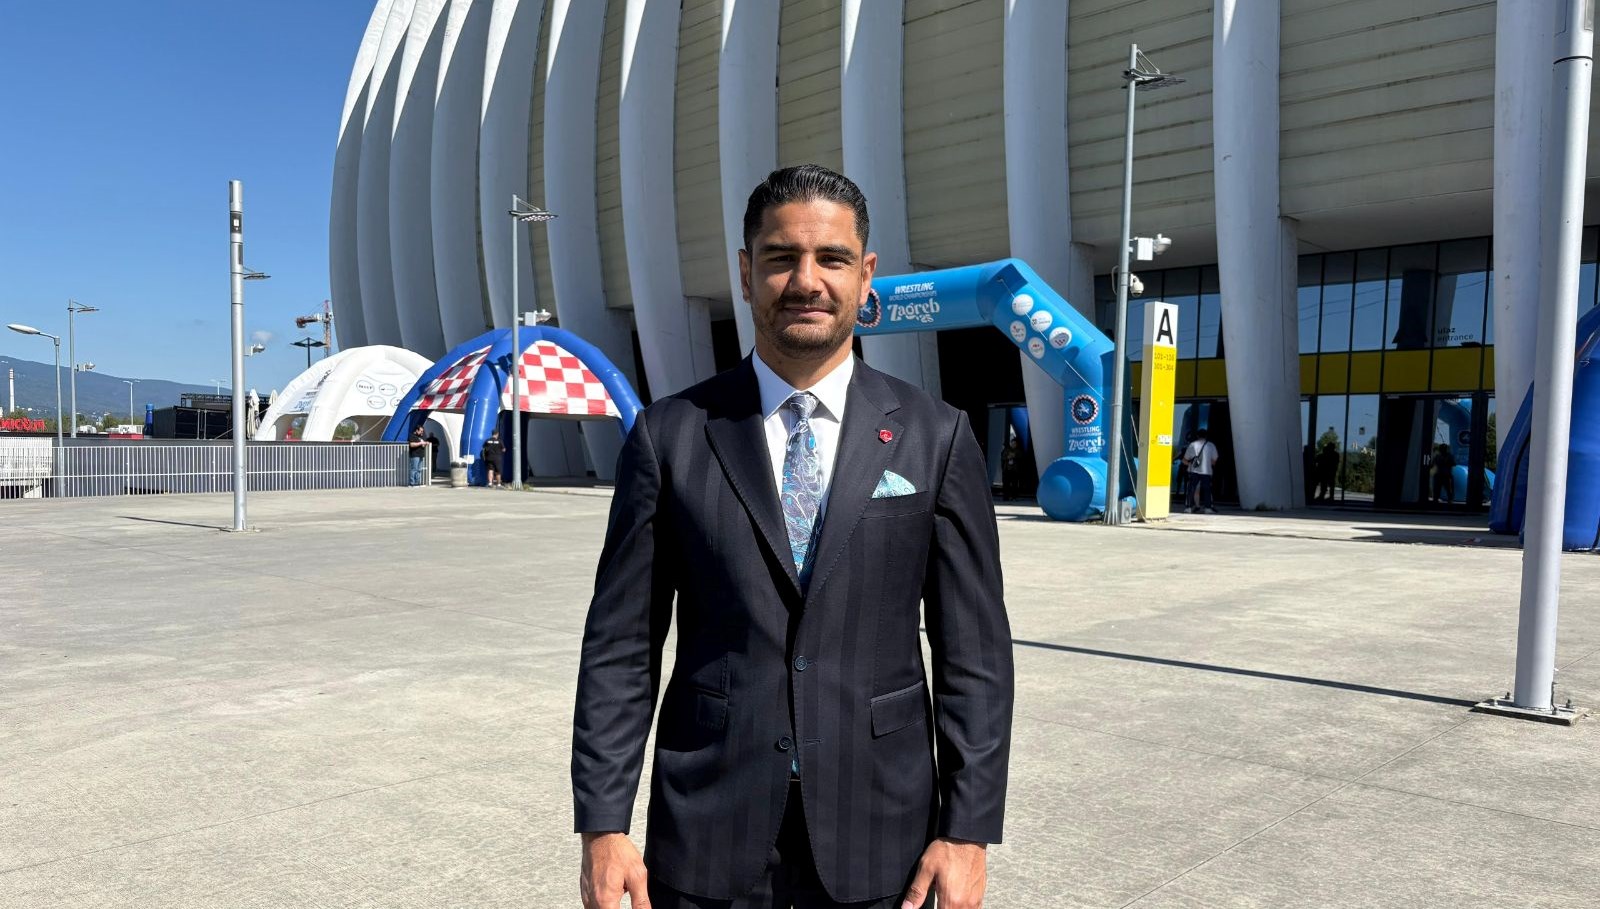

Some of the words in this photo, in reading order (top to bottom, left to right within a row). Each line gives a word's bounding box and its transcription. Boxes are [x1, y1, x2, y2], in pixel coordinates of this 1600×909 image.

[895, 282, 935, 294] WRESTLING
[887, 298, 940, 322] Zagreb
[1156, 308, 1174, 345] A
[1437, 333, 1474, 342] entrance
